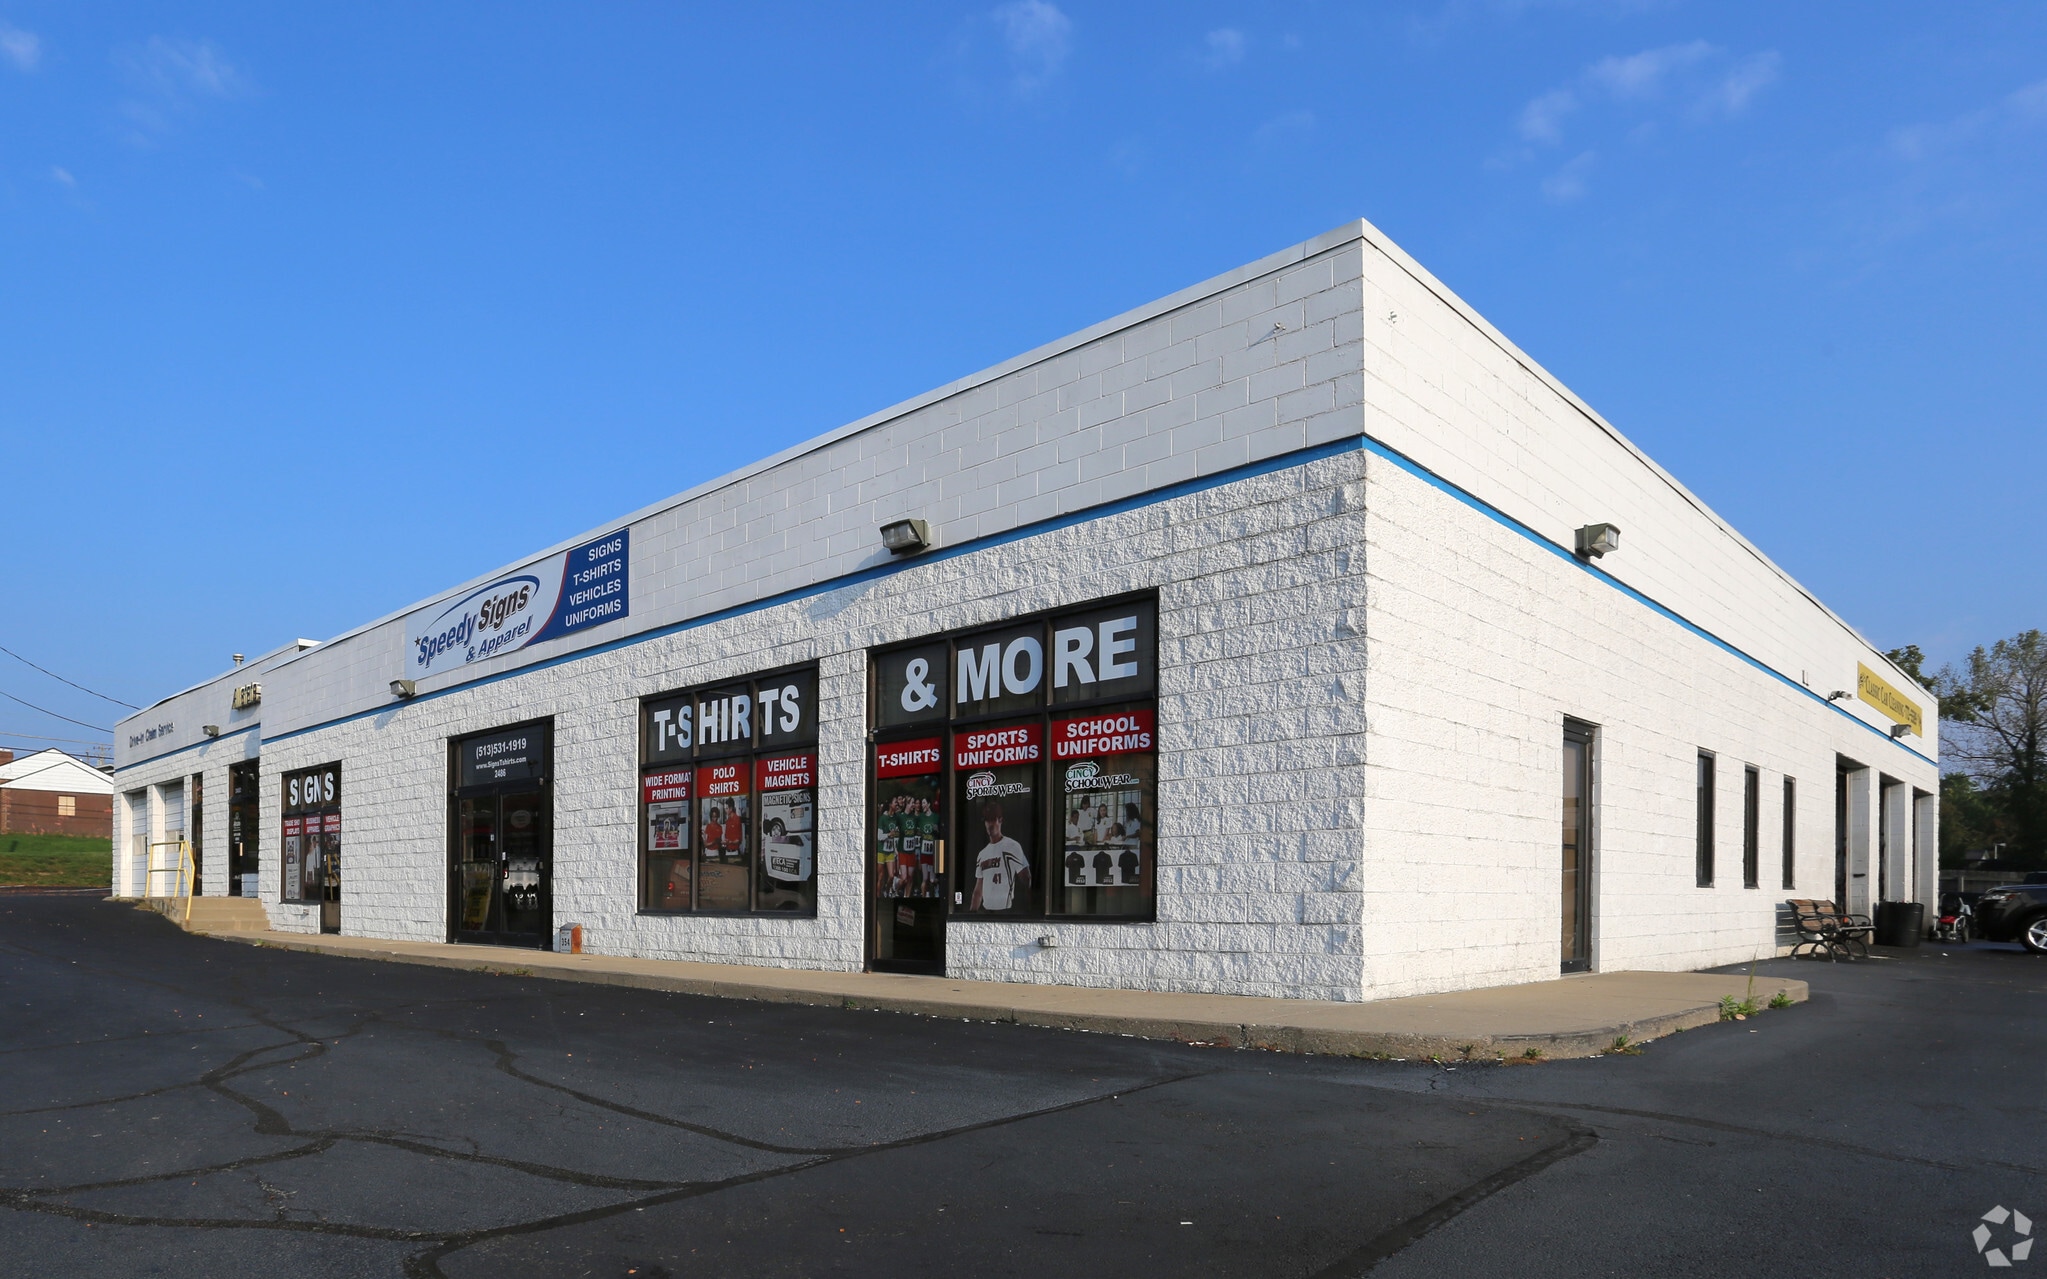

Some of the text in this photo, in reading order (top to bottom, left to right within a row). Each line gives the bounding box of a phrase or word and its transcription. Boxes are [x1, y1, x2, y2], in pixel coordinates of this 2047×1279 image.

[588, 538, 622, 562] SIGNS
[573, 558, 622, 586] T-SHIRTS
[569, 579, 622, 607] VEHICLES
[565, 598, 622, 627] UNIFORMS
[417, 584, 531, 668] Speedy Signs
[465, 614, 533, 663] & Apparel
[901, 615, 1138, 713] & MORE
[654, 684, 800, 752] T-SHIRTS
[1066, 716, 1140, 738] SCHOOL
[475, 738, 527, 760] (513)531-1919
[967, 729, 1028, 749] SPORTS
[1056, 732, 1151, 756] UNIFORMS
[767, 757, 808, 772] VEHICLE
[878, 748, 940, 768] T-SHIRTS
[957, 745, 1039, 767] UNIFORMS
[645, 771, 692, 787] WIDE FORMAT
[713, 766, 736, 780] POLO
[764, 773, 810, 788] MAGNETS
[966, 776, 992, 788] CINCY
[1065, 766, 1095, 780] CINCY
[289, 772, 335, 806] SIGNS
[651, 787, 686, 800] PRINTING
[709, 781, 740, 795] SHIRTS
[992, 872, 1001, 884] 41
